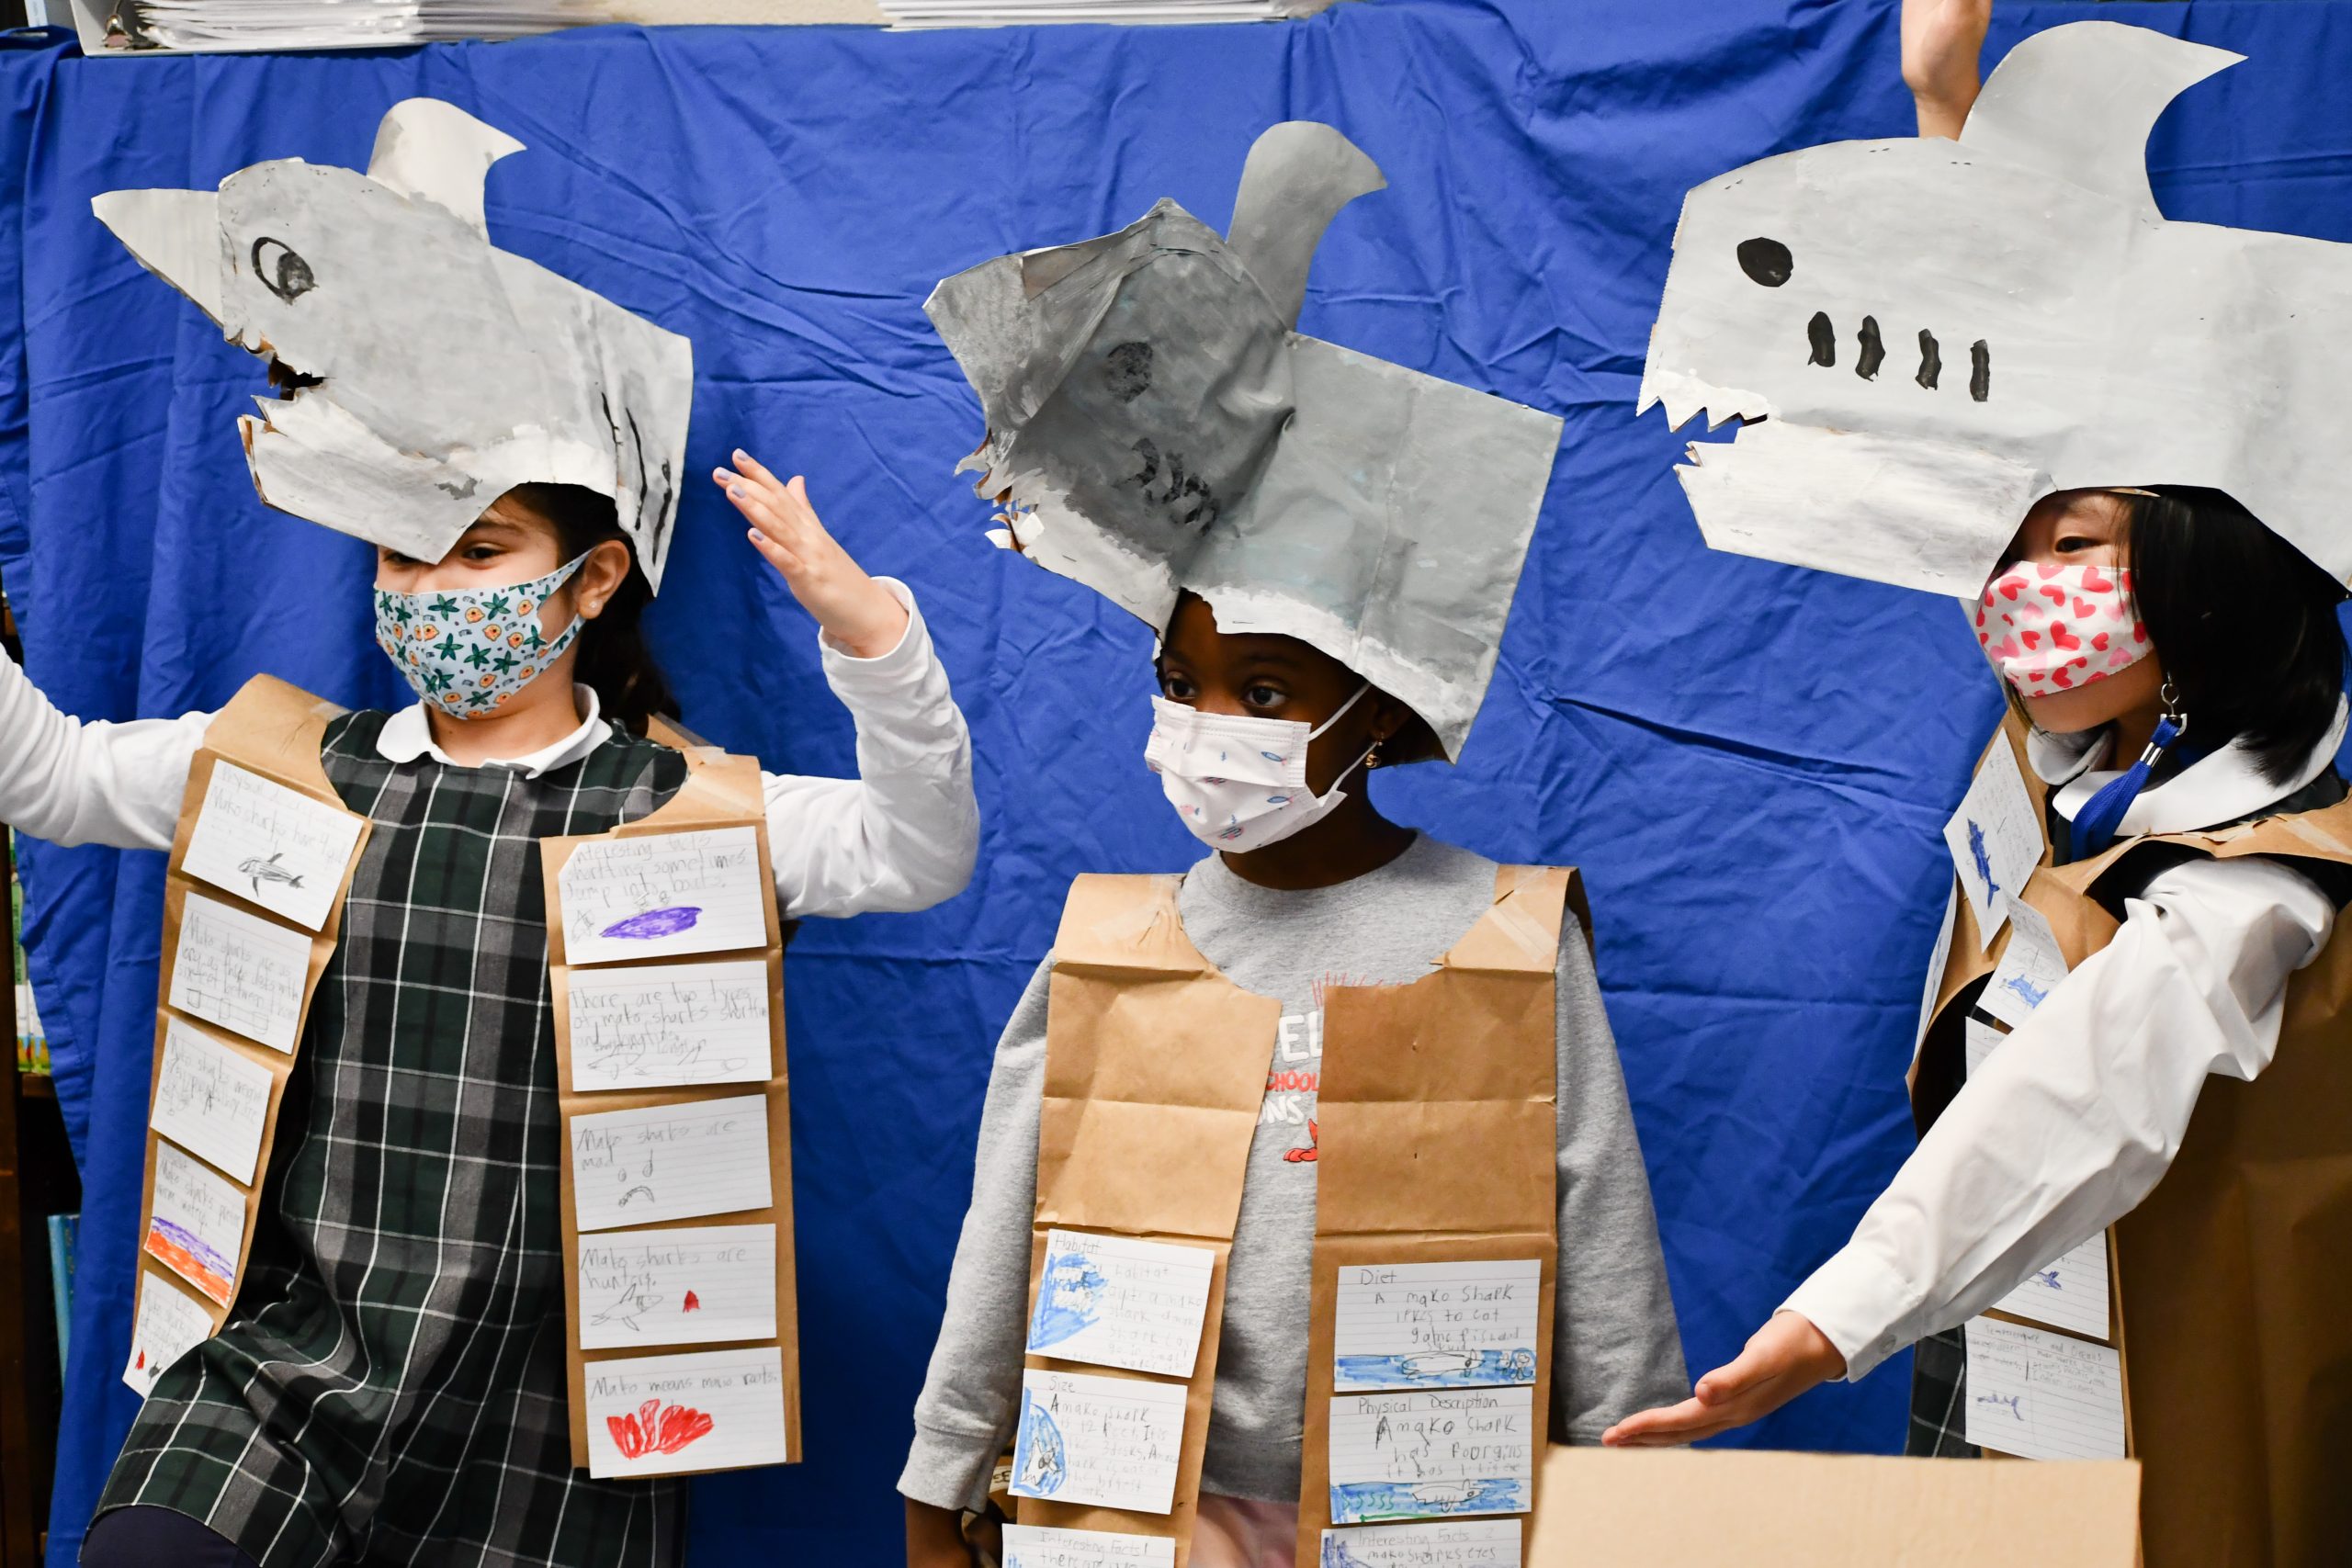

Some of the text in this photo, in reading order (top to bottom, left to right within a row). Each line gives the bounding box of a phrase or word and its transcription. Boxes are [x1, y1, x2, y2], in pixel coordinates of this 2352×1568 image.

[1266, 1069, 1318, 1092] CHOOL
[1360, 1269, 1396, 1285] Diet
[1374, 1292, 1386, 1304] A
[1444, 1309, 1464, 1322] to
[1049, 1375, 1076, 1393] Size
[1050, 1393, 1059, 1415] A
[1359, 1397, 1412, 1419] Physical
